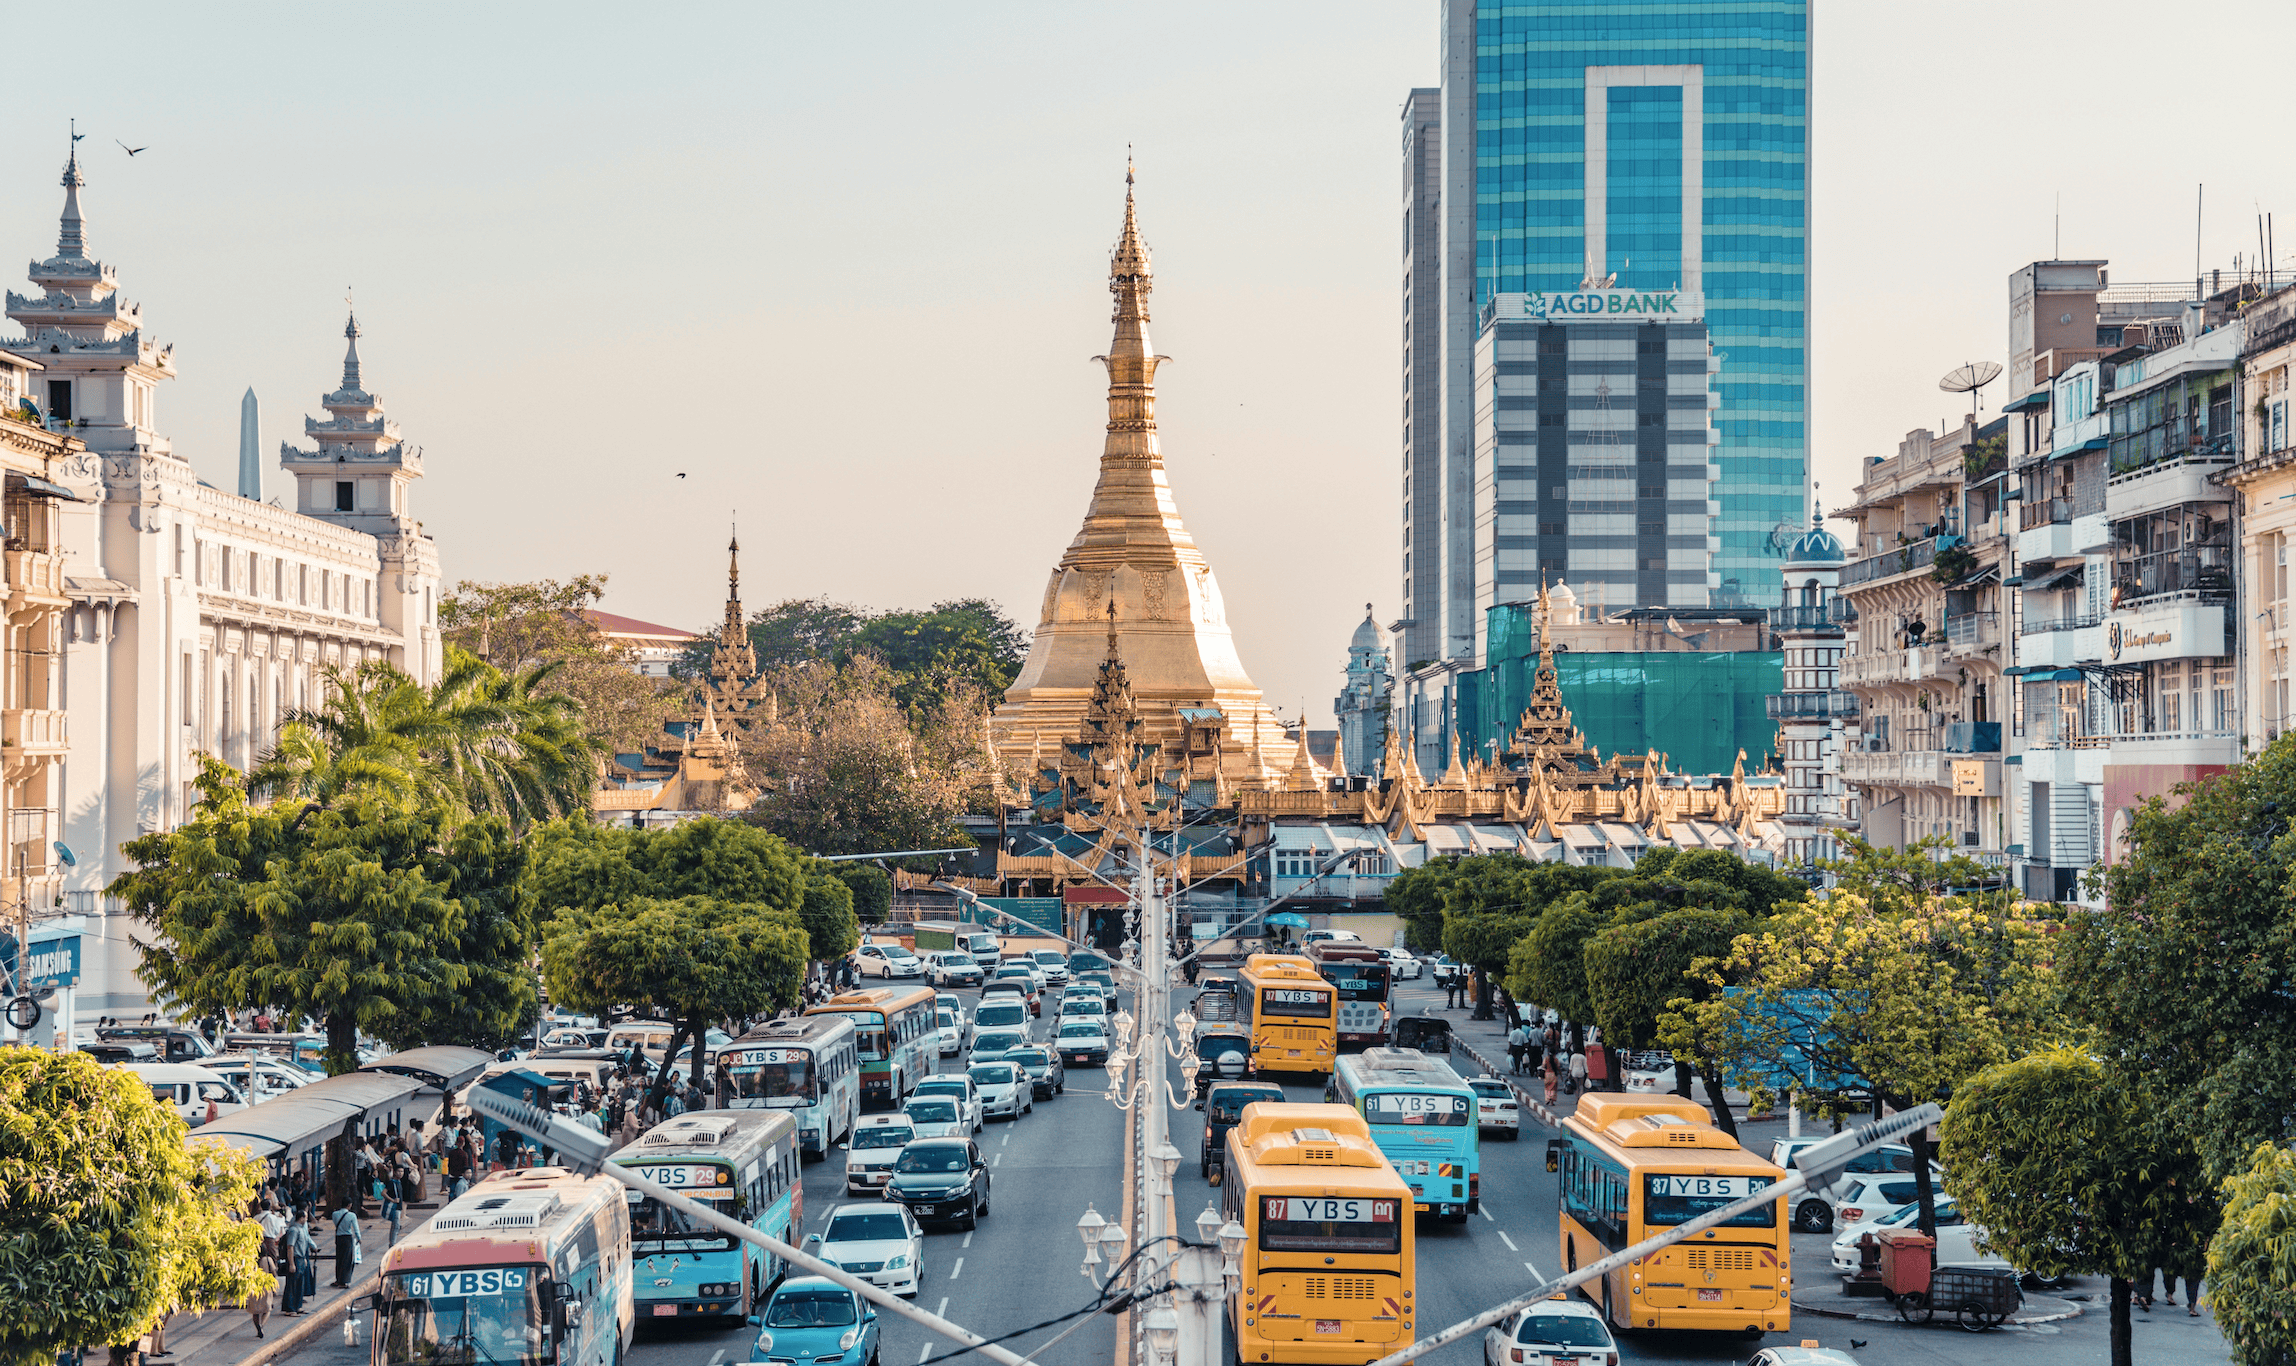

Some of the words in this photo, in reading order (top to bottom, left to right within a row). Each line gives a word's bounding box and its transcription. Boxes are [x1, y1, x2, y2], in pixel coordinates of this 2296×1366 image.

[1550, 294, 1604, 314] AGD
[1607, 294, 1678, 314] BANK
[29, 949, 72, 979] SAMSUNG
[1344, 980, 1364, 989] YBS
[1265, 990, 1276, 1001] 87
[1282, 991, 1312, 1002] YBS
[744, 1051, 778, 1062] YBS
[786, 1051, 800, 1062] 29
[1366, 1098, 1379, 1111] 61
[1395, 1097, 1436, 1112] YBS
[641, 1167, 686, 1185] YBS
[695, 1169, 715, 1185] 29
[1652, 1178, 1669, 1195] 37
[1675, 1178, 1731, 1195] YBS
[1268, 1199, 1286, 1219] 87
[1302, 1200, 1359, 1220] YBS
[411, 1276, 430, 1296] 61
[437, 1271, 500, 1295] YBS
